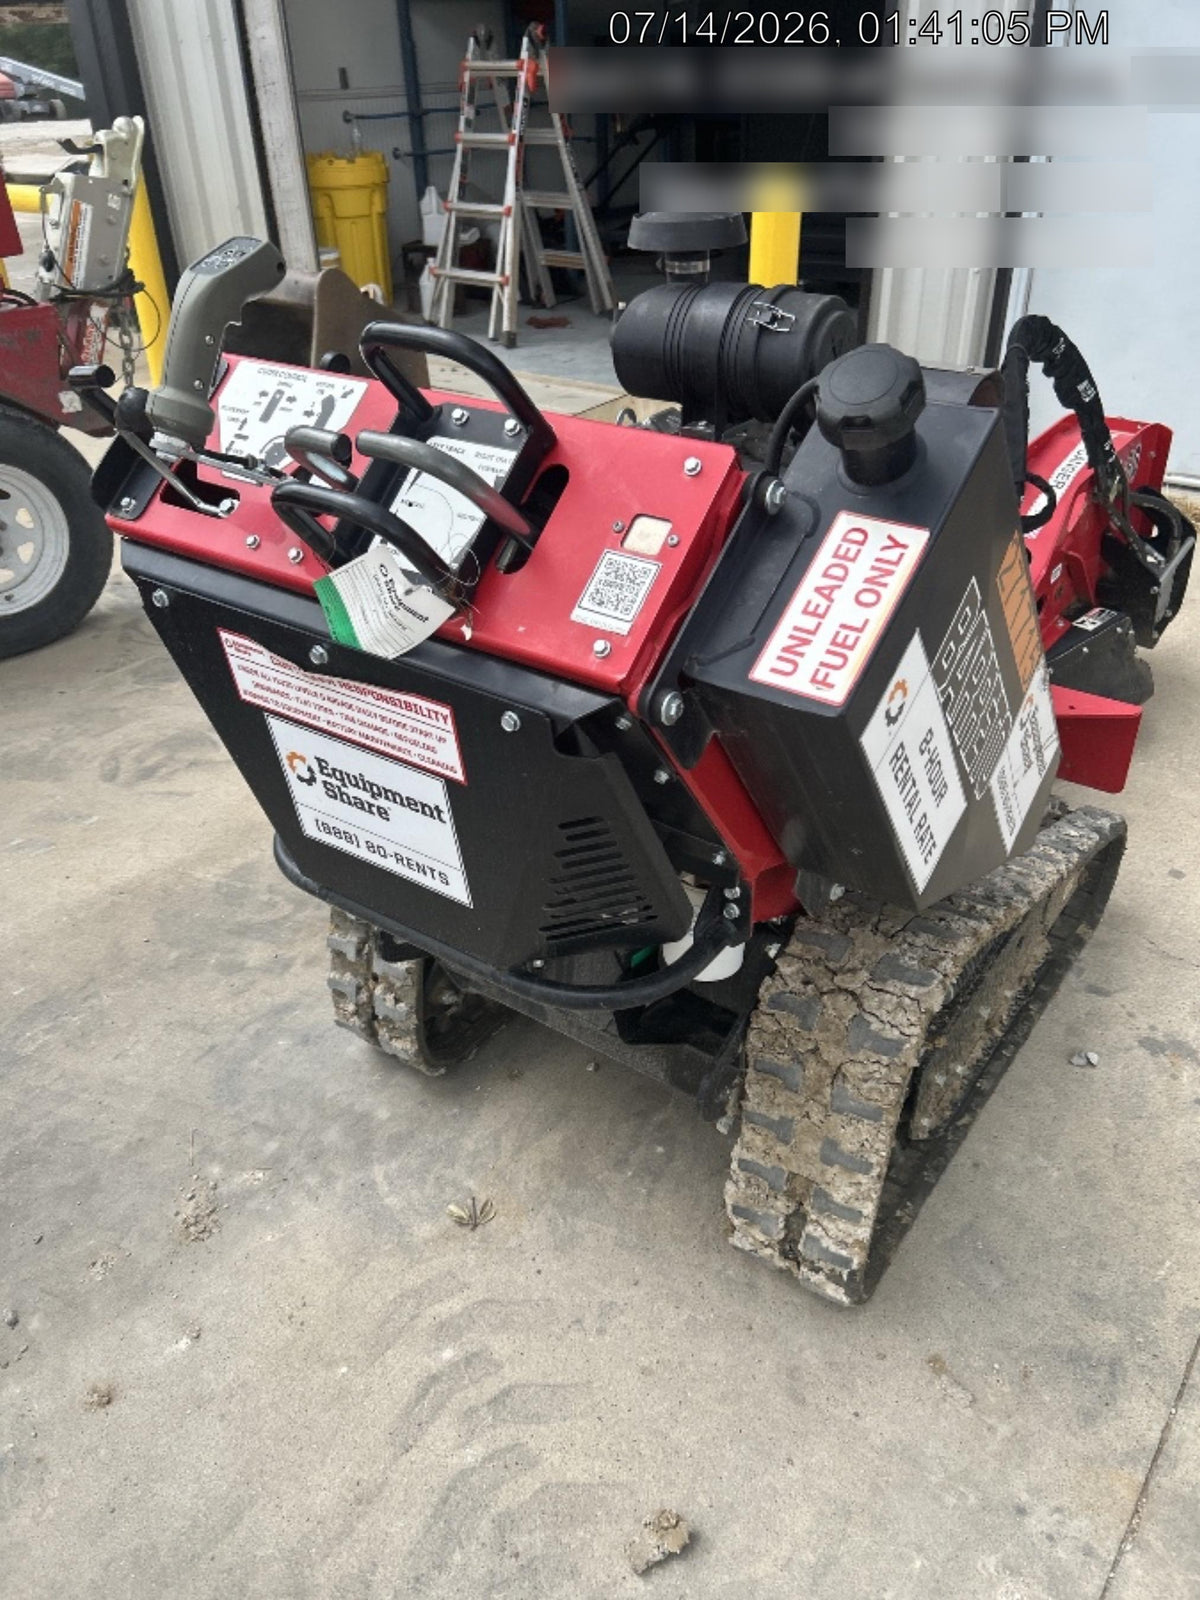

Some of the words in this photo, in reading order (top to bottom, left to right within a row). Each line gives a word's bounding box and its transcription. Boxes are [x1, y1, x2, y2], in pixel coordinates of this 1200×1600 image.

[769, 526, 870, 679] UNLEADED
[809, 619, 868, 690] FUEL
[856, 533, 910, 610] ONLY
[314, 756, 447, 824] Equipment
[322, 780, 390, 822] Share
[889, 741, 923, 824] RENTAL
[913, 812, 938, 865] RATE
[918, 727, 949, 808] 8-HOUR
[314, 818, 361, 849] (888)
[365, 840, 450, 887] 80-RENTS
